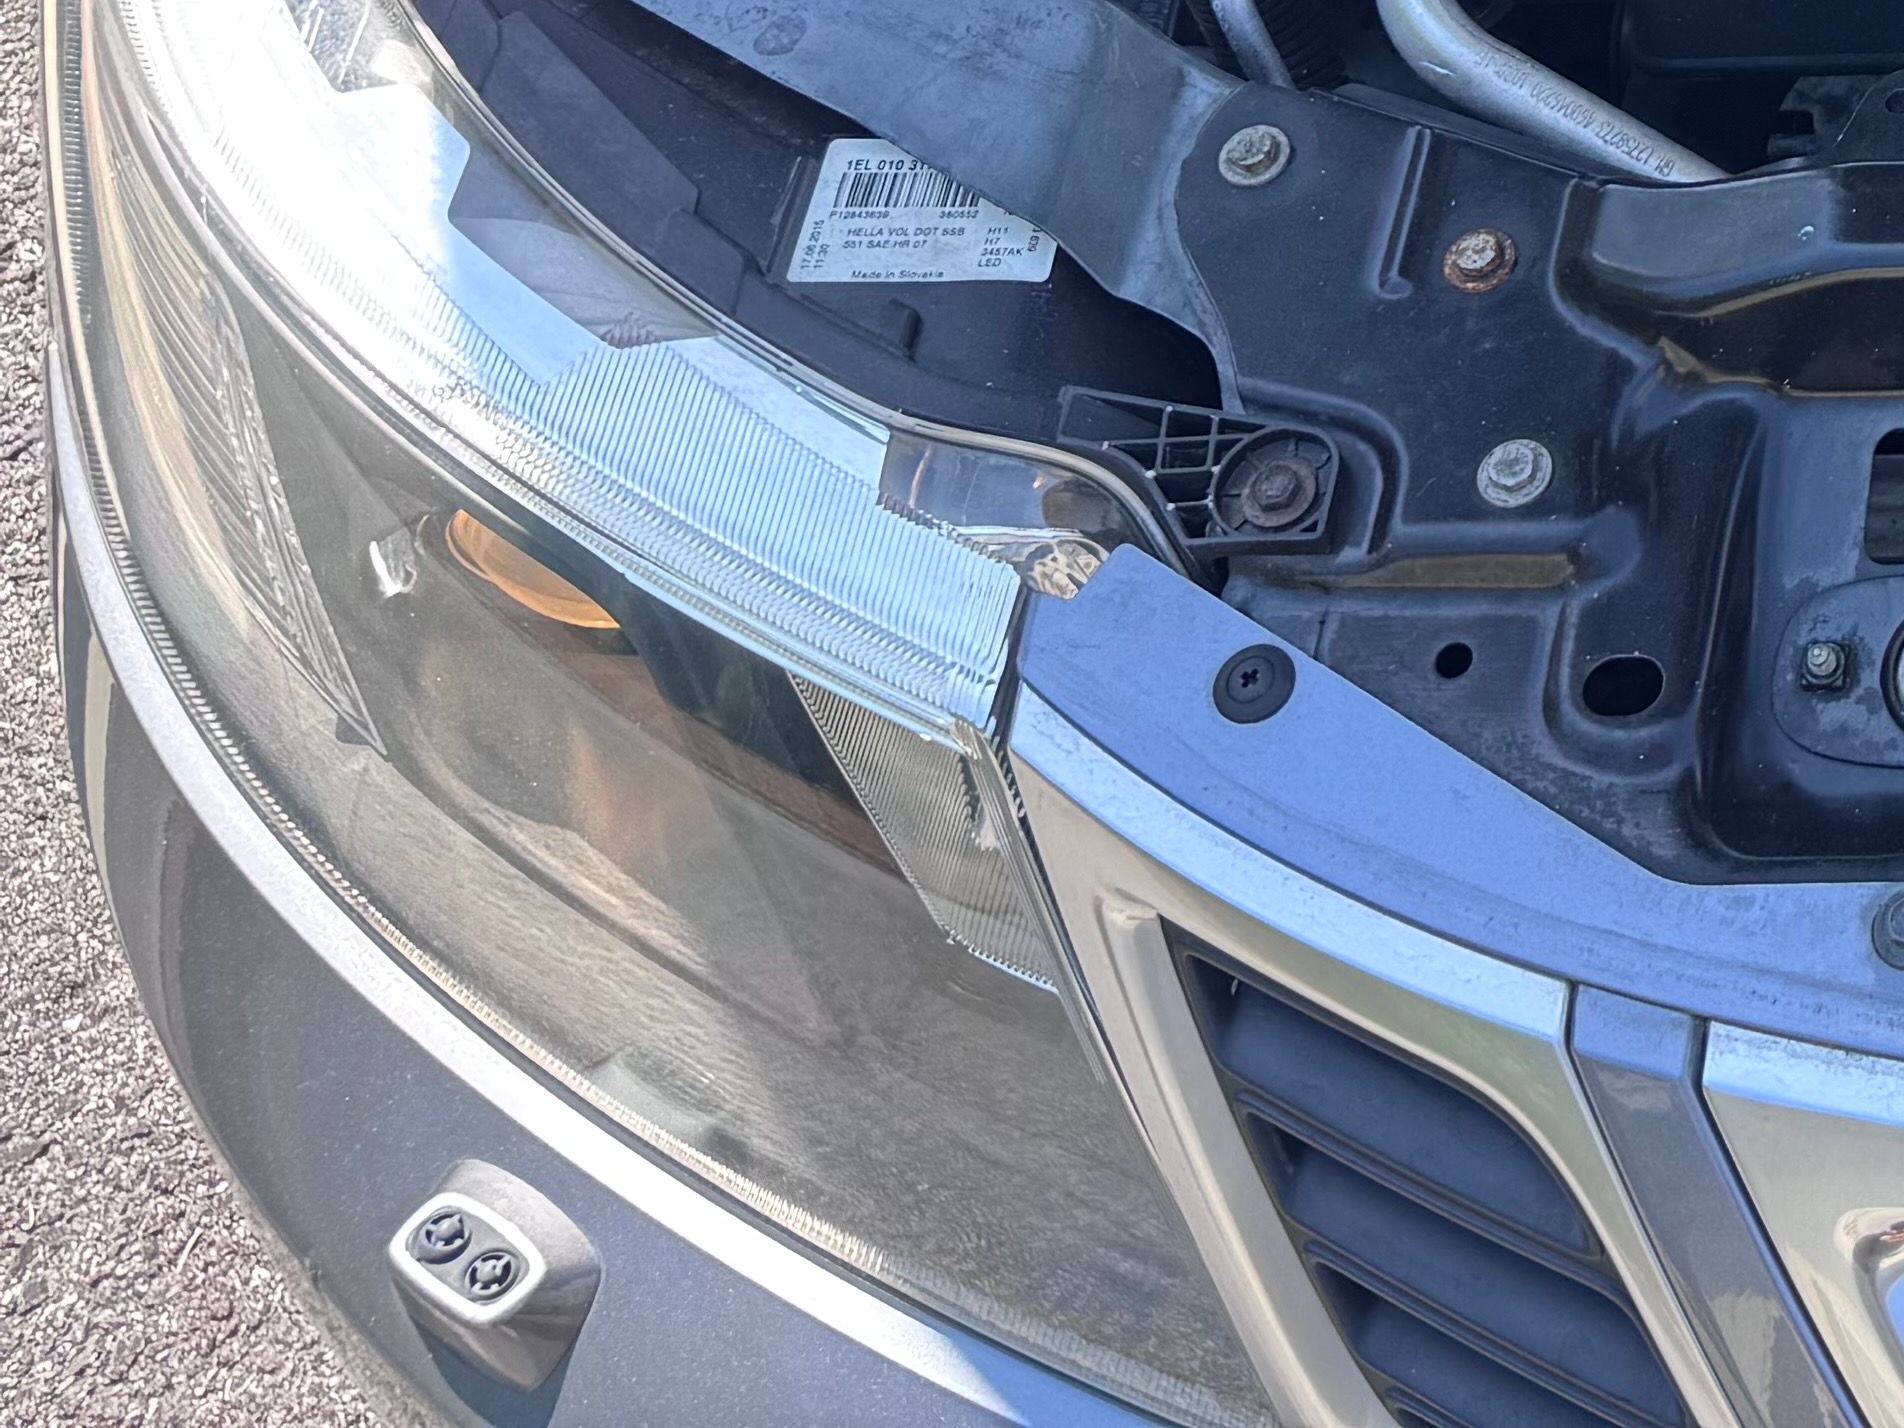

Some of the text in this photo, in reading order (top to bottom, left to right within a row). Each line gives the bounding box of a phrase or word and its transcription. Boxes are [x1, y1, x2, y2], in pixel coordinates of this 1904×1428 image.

[847, 158, 905, 170] 1EL 010
[847, 226, 939, 237] HELLA VOL DOT
[866, 239, 890, 249] SAE
[977, 257, 1002, 268] LED
[852, 269, 882, 279] Made
[885, 269, 895, 279] in
